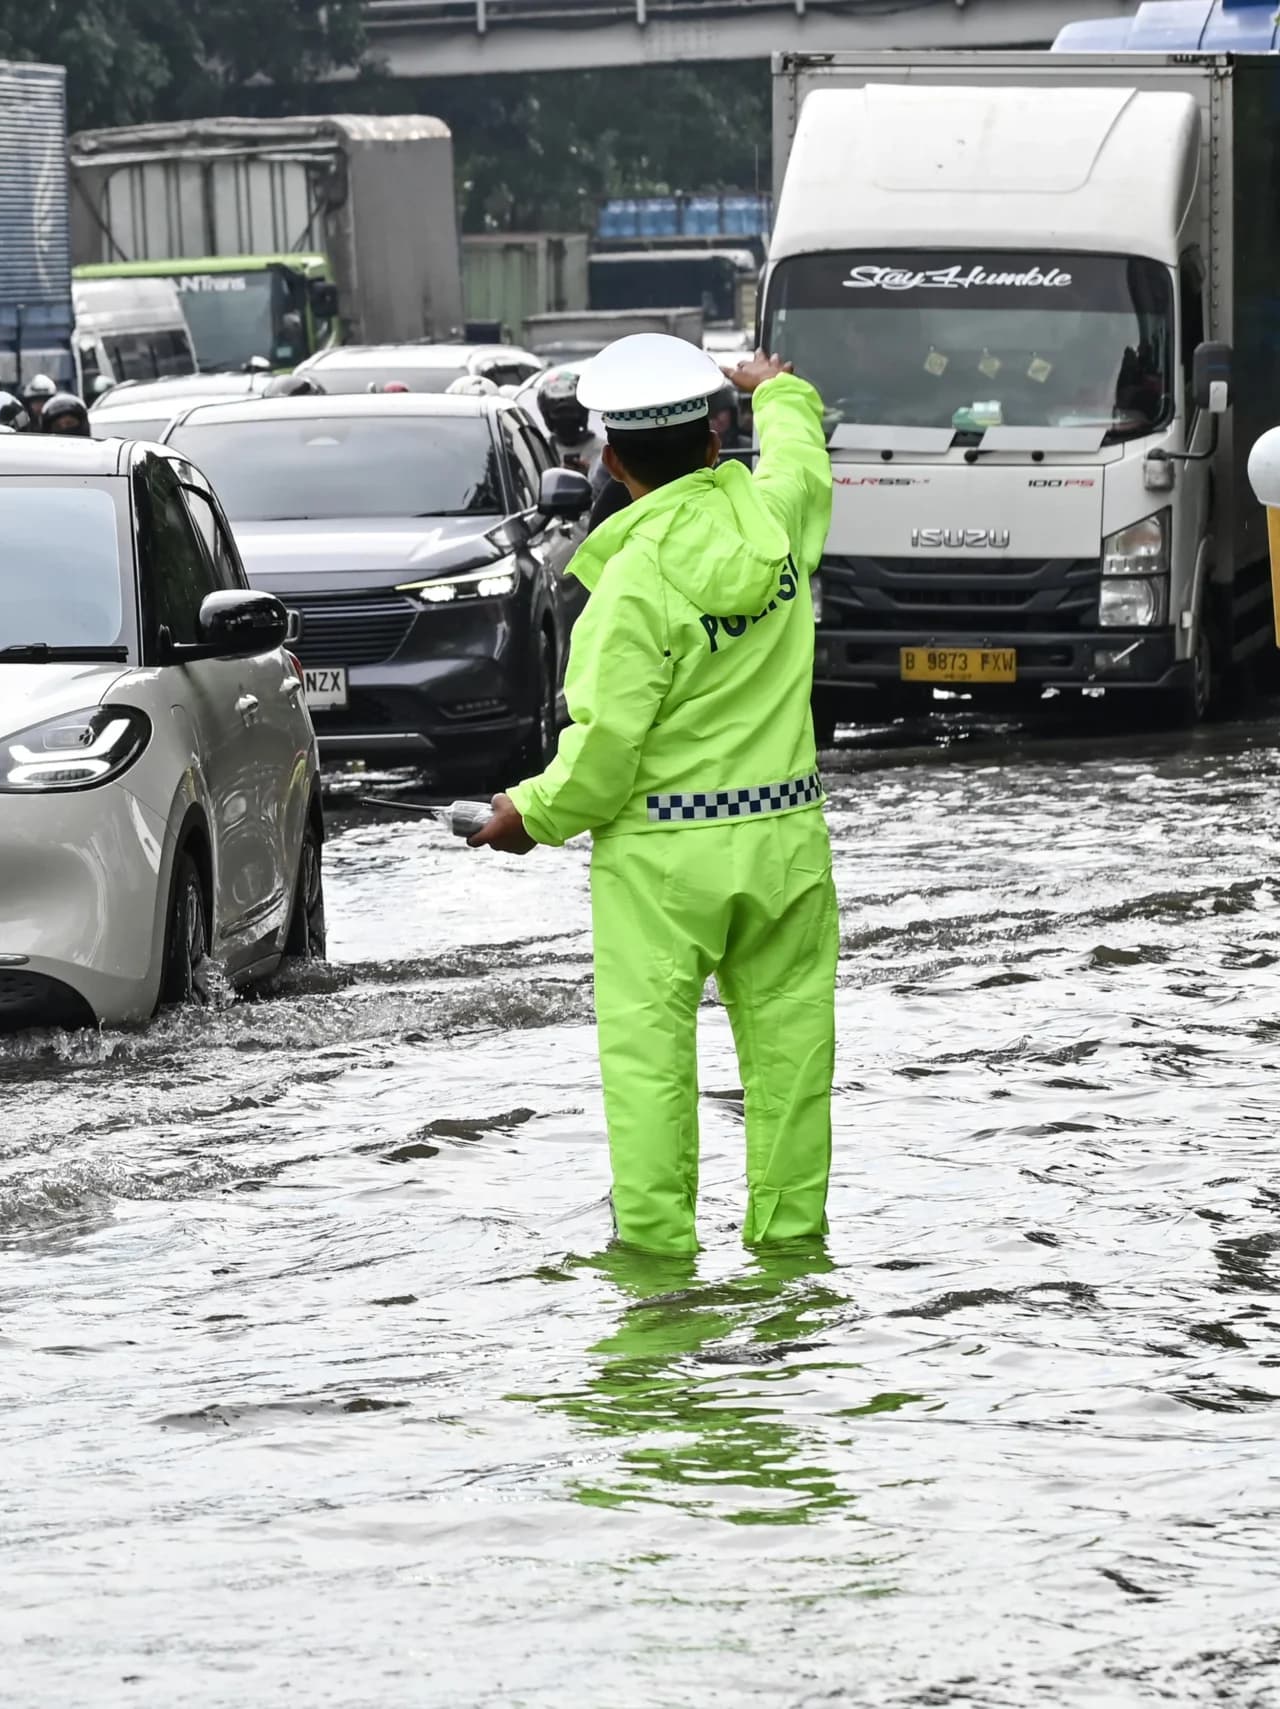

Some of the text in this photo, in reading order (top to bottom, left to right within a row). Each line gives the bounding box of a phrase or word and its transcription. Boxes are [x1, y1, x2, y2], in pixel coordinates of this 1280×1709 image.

[842, 265, 1072, 290] Stay Humble
[1028, 479, 1096, 487] 100 PS
[910, 528, 1010, 549] ISUZU
[905, 651, 1014, 671] B 9873 FXW
[306, 671, 341, 692] NZX
